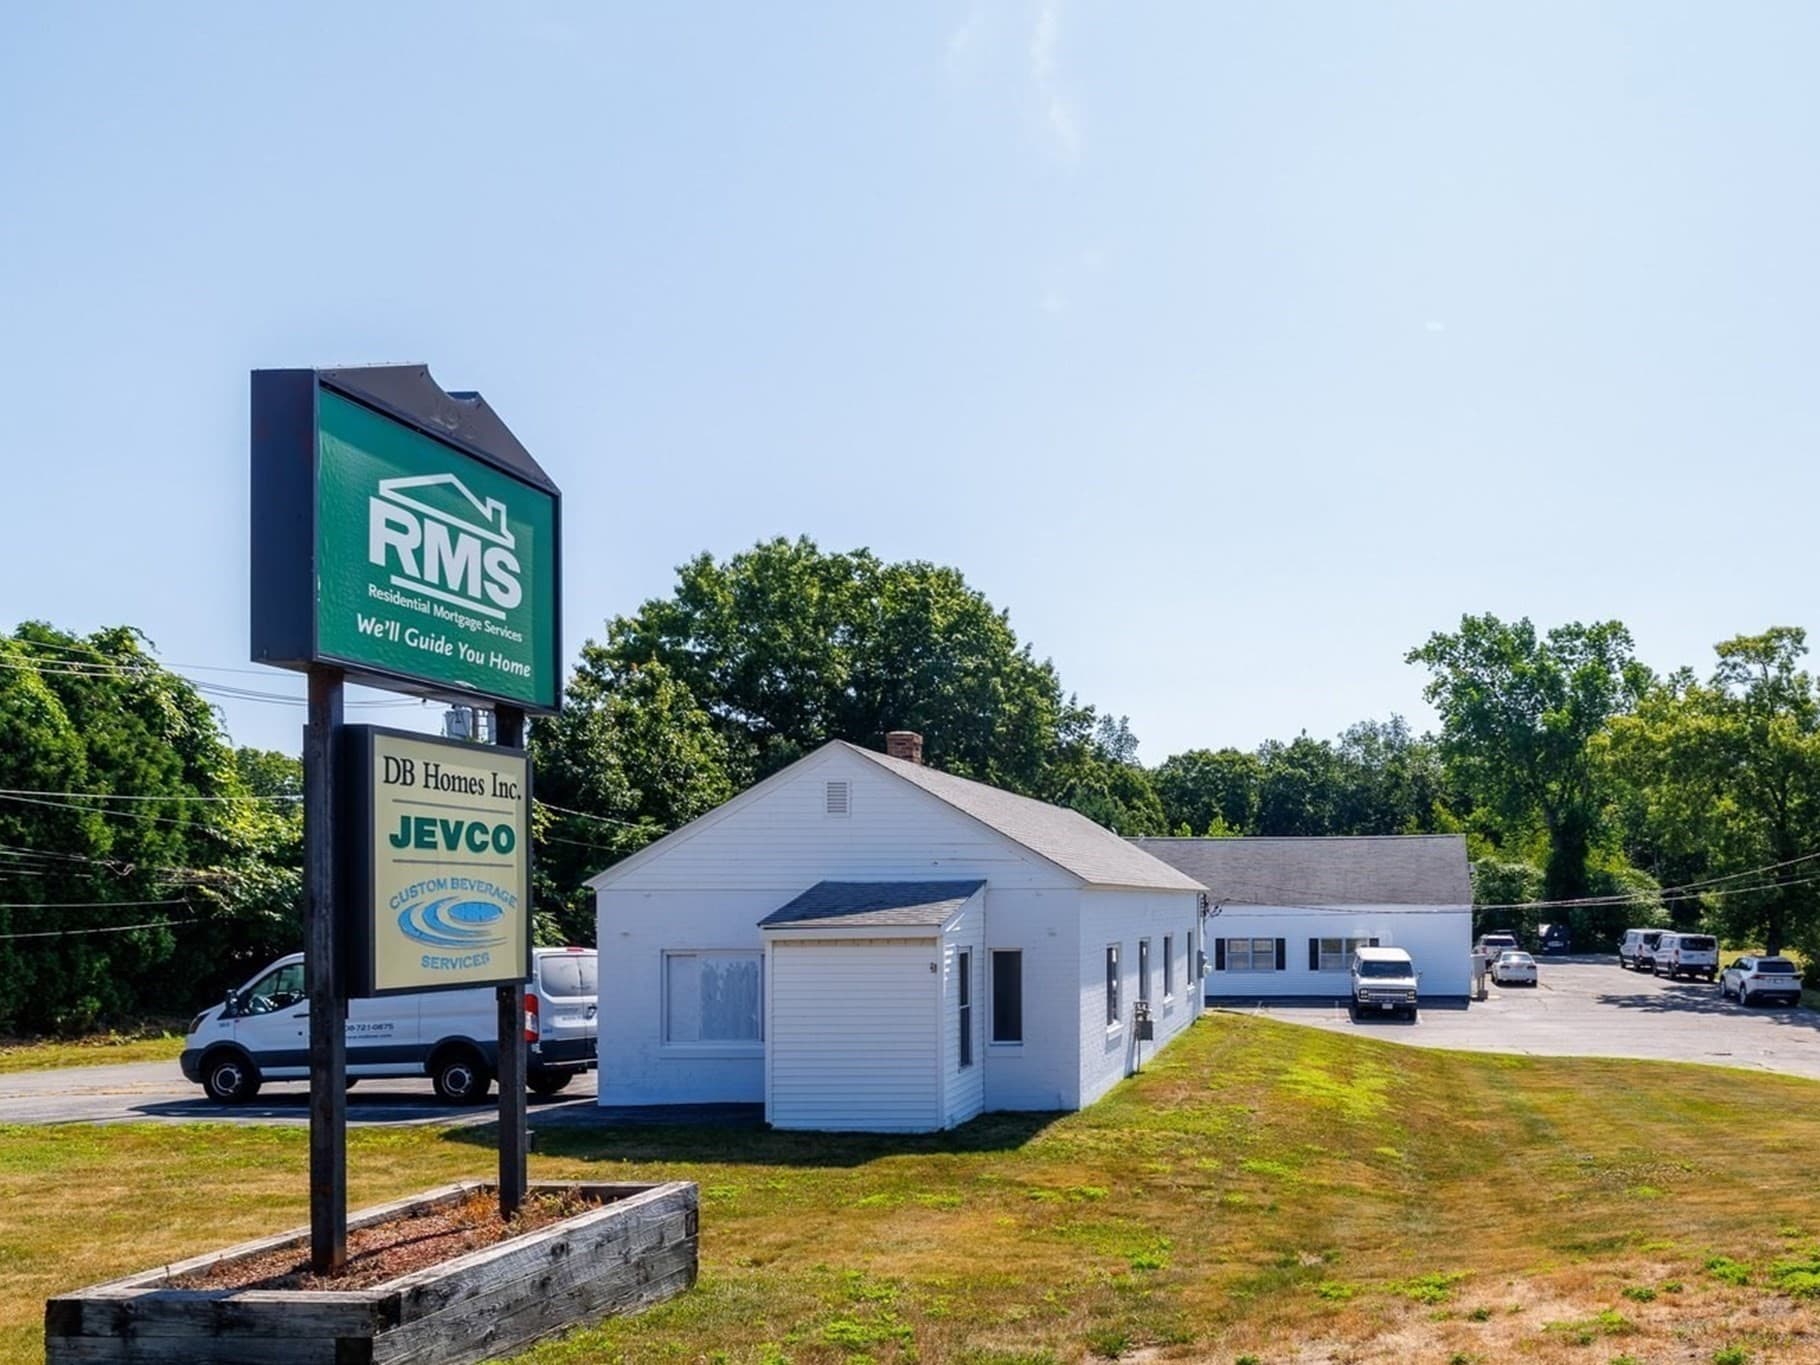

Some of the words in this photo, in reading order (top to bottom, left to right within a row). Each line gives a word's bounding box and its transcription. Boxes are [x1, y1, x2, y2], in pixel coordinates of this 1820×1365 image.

[369, 496, 522, 609] RMS
[368, 583, 430, 618] Residential
[433, 604, 482, 632] Mortgage
[484, 620, 523, 643] Services
[356, 613, 399, 642] We'll
[404, 628, 453, 656] Guide
[458, 643, 485, 666] You
[489, 653, 532, 678] Home
[383, 756, 415, 787] DB
[423, 762, 485, 796] Homes
[491, 772, 522, 800] Inc.
[389, 815, 516, 855] JEVCO
[389, 878, 448, 910] CUSTOM
[450, 877, 518, 909] BEVERAGE
[421, 952, 491, 971] SERVICES
